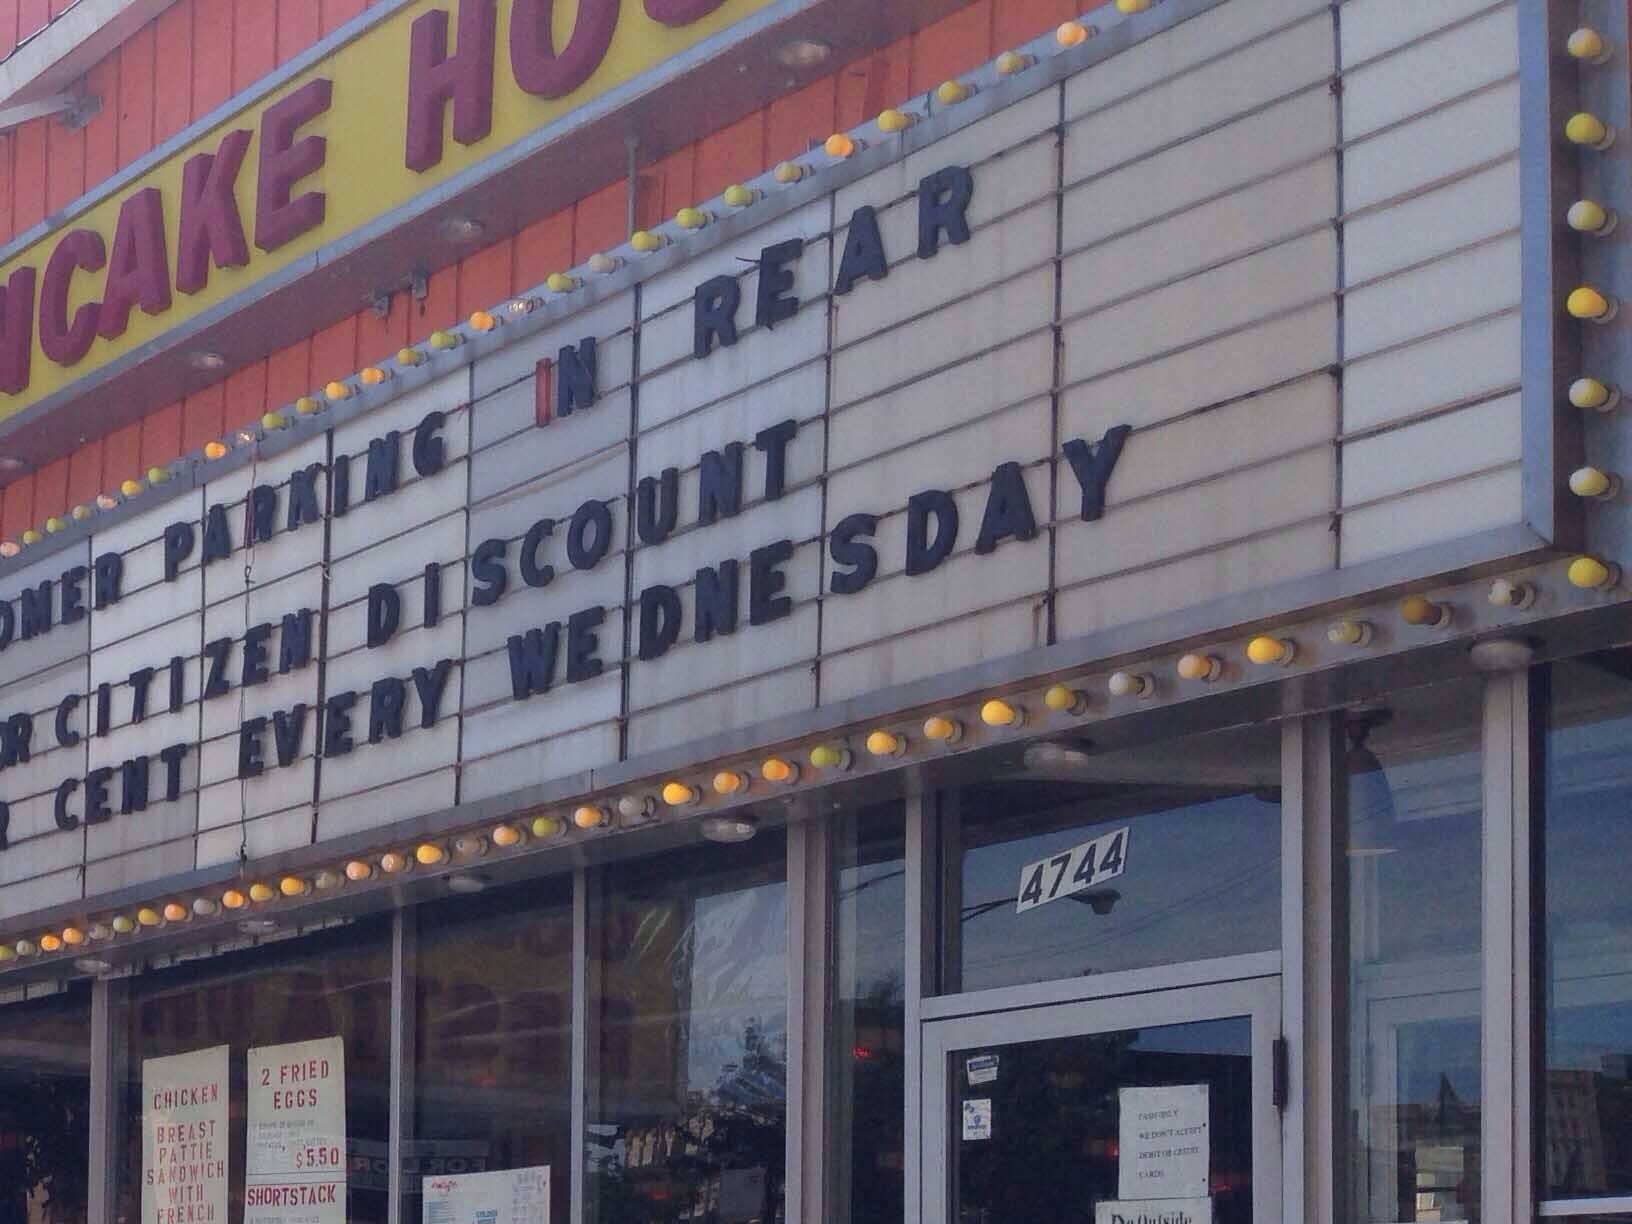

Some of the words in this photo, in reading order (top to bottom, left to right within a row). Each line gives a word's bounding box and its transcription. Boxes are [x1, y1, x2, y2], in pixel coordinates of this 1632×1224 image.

[405, 0, 728, 173] HO
[164, 410, 445, 582] PARKING
[535, 336, 598, 428] IN
[693, 165, 973, 359] REAR
[55, 608, 312, 748] CITIZEN
[368, 419, 797, 649] DISCOUNT
[54, 743, 186, 831] CENT
[238, 658, 453, 779] EVERY
[507, 423, 1132, 701] WEDNESDAY
[1020, 833, 1123, 904] 4744
[262, 1068, 270, 1086] 2
[280, 1060, 329, 1084] FRIED
[153, 1083, 218, 1110] CHICKEN
[273, 1088, 317, 1110] EGGS
[157, 1120, 216, 1144] BREAST
[159, 1142, 212, 1164] PATTIE
[147, 1160, 224, 1185] SANDWICH
[169, 1184, 204, 1204] WITH
[247, 1183, 336, 1207] SHORTSTACK
[157, 1204, 214, 1224] FRENCH
